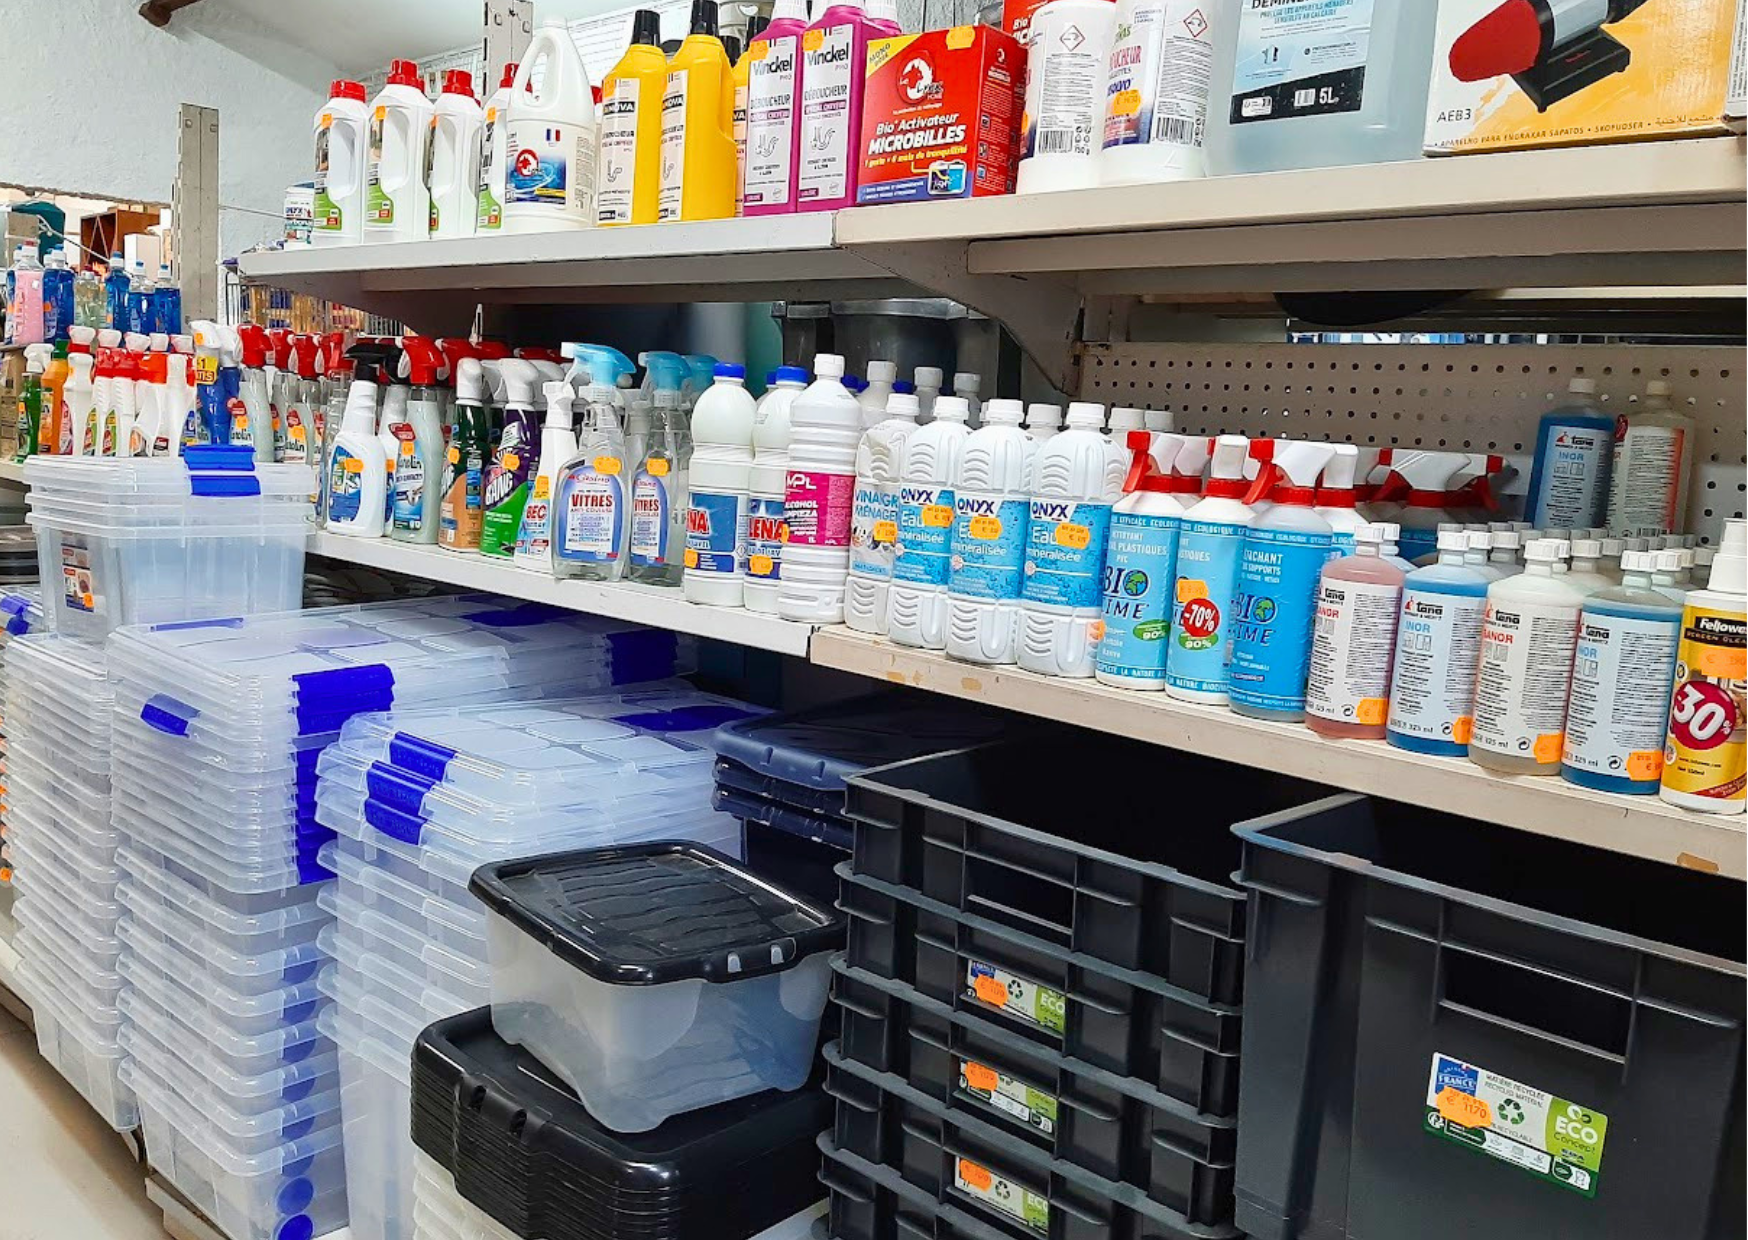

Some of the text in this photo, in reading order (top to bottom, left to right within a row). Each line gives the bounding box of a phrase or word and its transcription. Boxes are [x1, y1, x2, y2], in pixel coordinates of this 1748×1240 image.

[807, 42, 849, 66] Vinckel
[753, 53, 793, 76] Vinckel
[897, 113, 960, 132] Activateur
[1437, 108, 1472, 123] AEB3
[868, 125, 967, 155] MICROBILLES
[1549, 127, 1584, 137] SAPATOS
[1558, 451, 1585, 462] INOR
[485, 472, 513, 506] BANG
[900, 488, 934, 504] ONYX
[571, 494, 613, 508] VITRES
[634, 498, 659, 512] VITRES
[854, 489, 899, 508] VINAIGR
[957, 498, 995, 514] ONYX
[1031, 501, 1069, 518] ONYX
[901, 510, 926, 528] Eau
[1031, 526, 1059, 546] Eau
[1118, 542, 1168, 556] PLASTIQUES
[1416, 601, 1444, 616] tana
[1495, 608, 1521, 625] tana
[1184, 602, 1216, 633] -70%
[1585, 623, 1611, 640] tana
[1722, 635, 1747, 645] CLEA
[1041, 992, 1065, 1013] ECO
[1437, 1075, 1476, 1088] FRANCE
[1464, 1103, 1487, 1119] 1170
[1555, 1115, 1599, 1145] ECO
[1554, 1131, 1596, 1155] Concept
